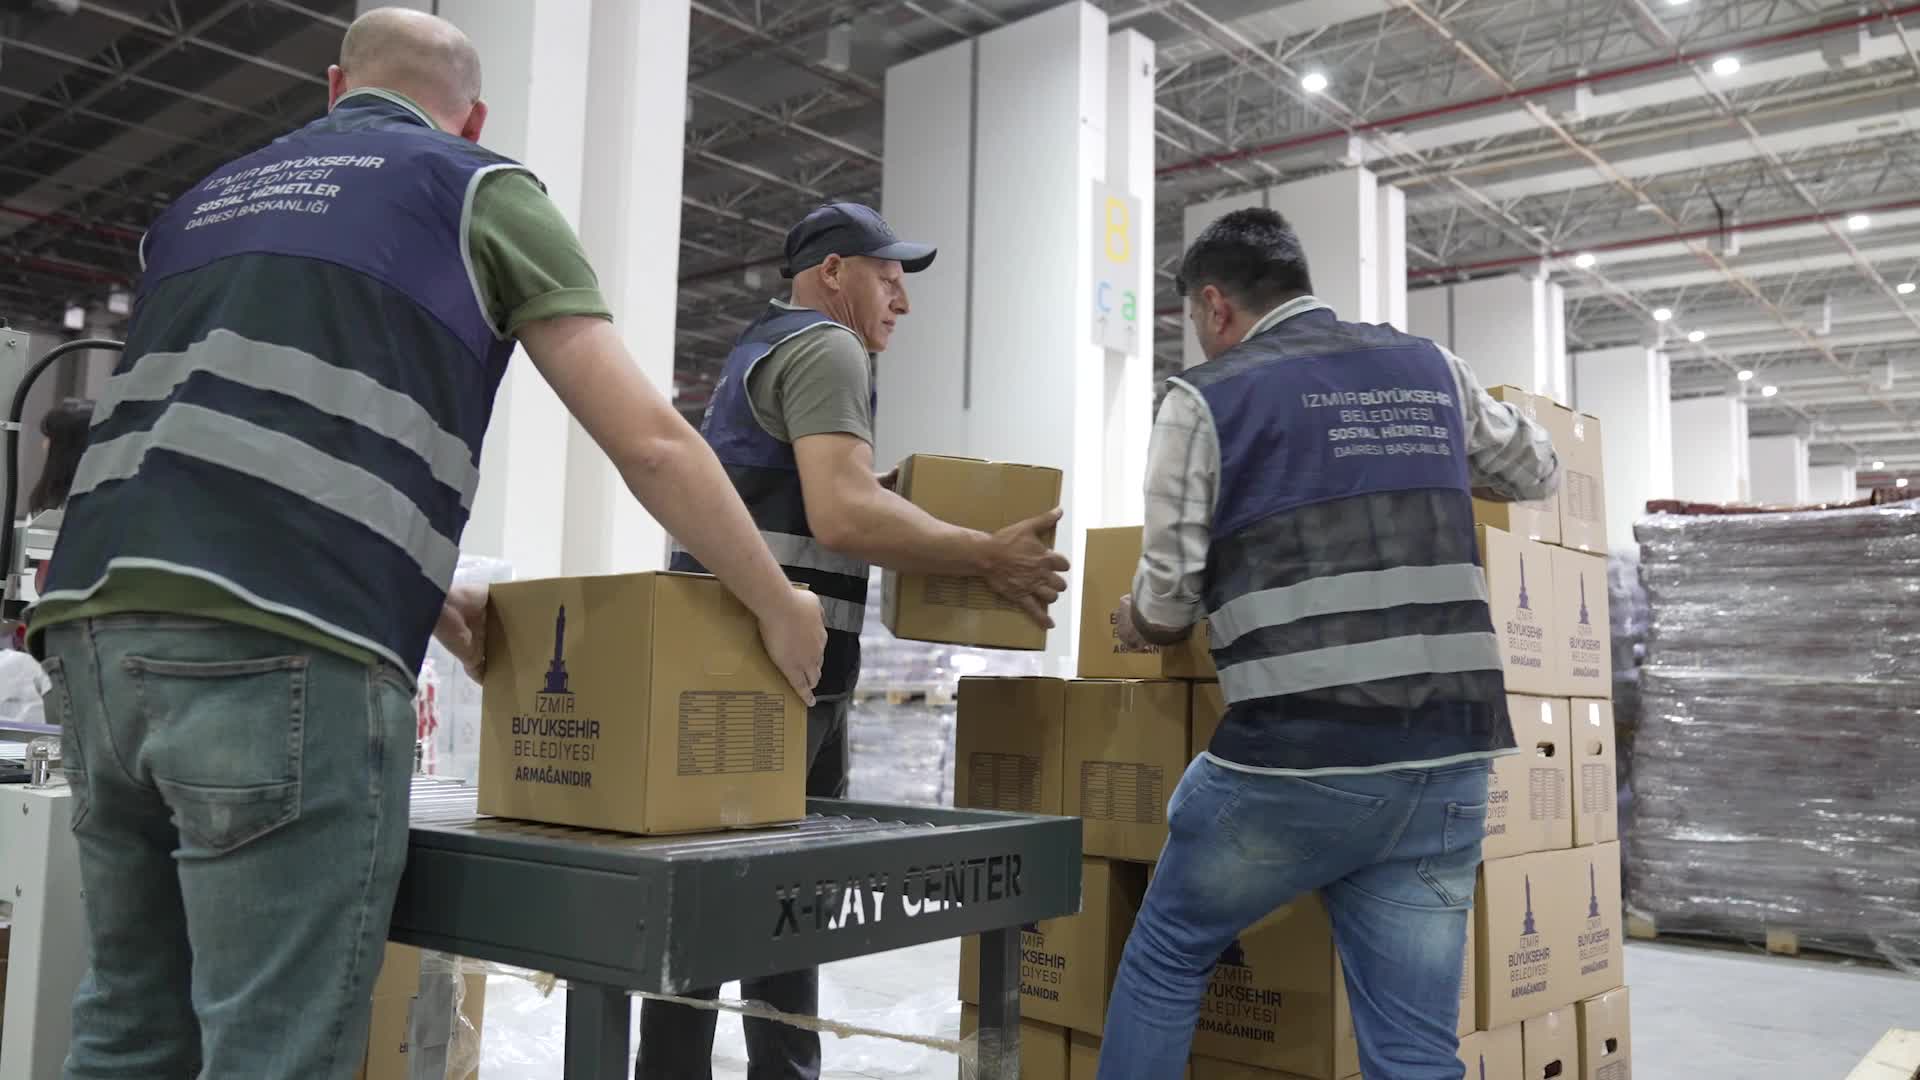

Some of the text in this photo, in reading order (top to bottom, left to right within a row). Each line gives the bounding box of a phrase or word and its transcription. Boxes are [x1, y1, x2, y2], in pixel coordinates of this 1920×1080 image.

[193, 194, 245, 214] SOSYAL
[237, 199, 330, 217] BAŞKANLIĞI
[1104, 196, 1131, 262] B
[1121, 291, 1137, 320] a
[1302, 391, 1359, 408] İZMİR
[1328, 426, 1380, 441] SOSYAL
[535, 695, 576, 713] İZMİR
[514, 740, 596, 761] BELEDİYESİ
[515, 765, 592, 788] ARMAĞANIDIR
[771, 854, 1023, 940] X-RAY CENTER
[1022, 934, 1045, 948] MİR
[1022, 965, 1062, 984] DİYESİ
[1018, 982, 1060, 1002] ĞANIDIR
